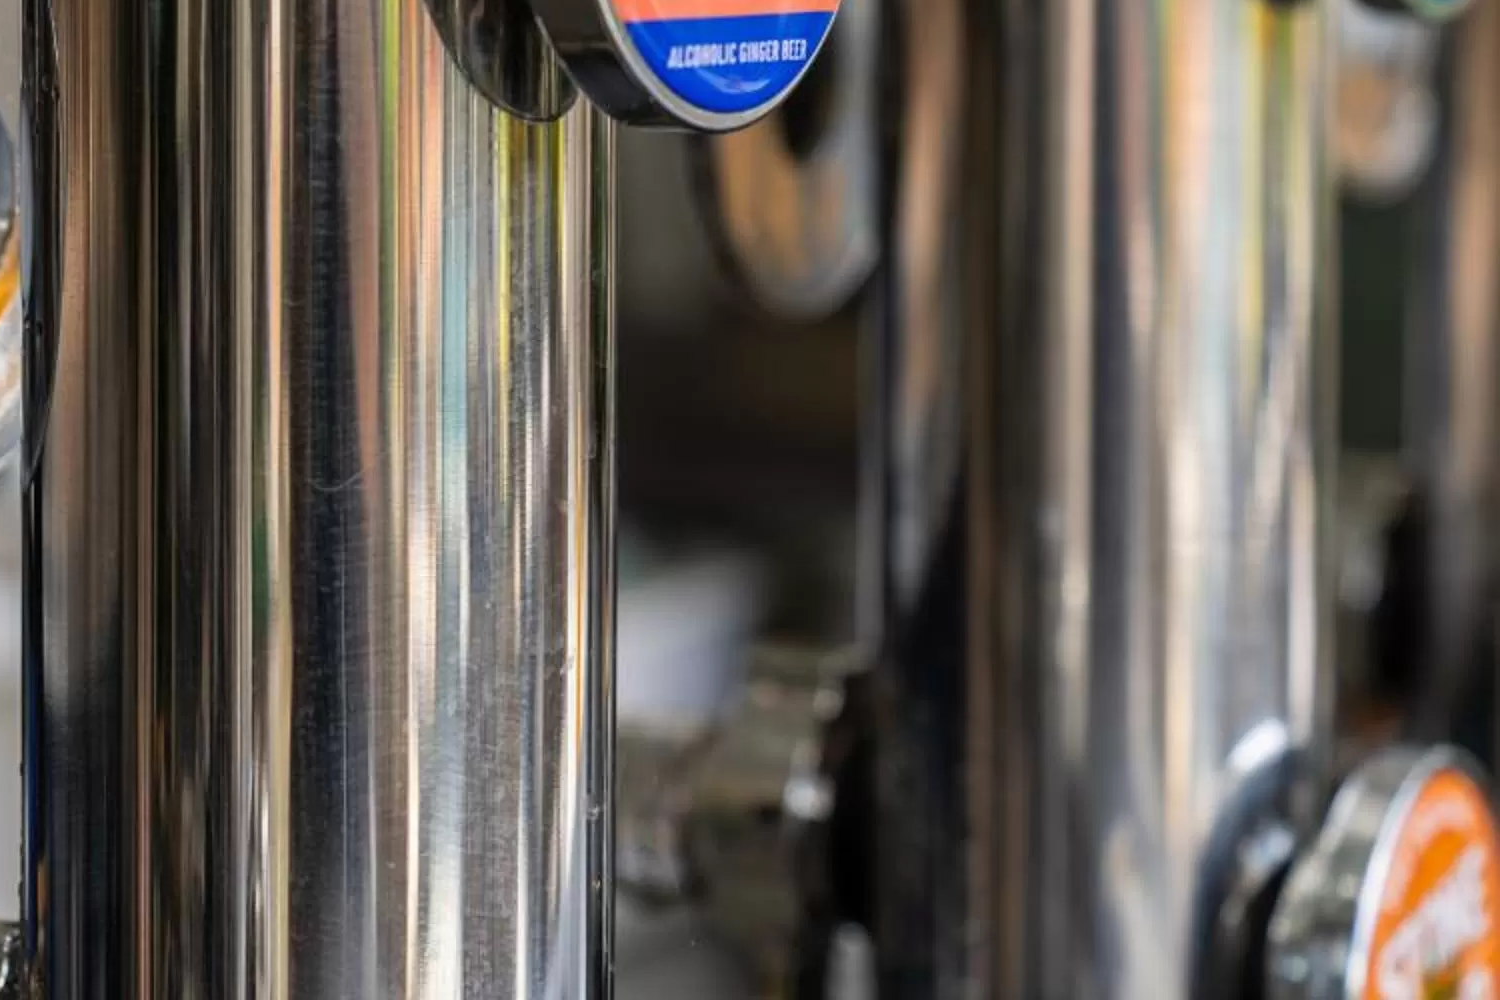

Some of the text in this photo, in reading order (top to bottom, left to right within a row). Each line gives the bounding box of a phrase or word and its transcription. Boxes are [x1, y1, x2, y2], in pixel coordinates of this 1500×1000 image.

[666, 38, 807, 69] ALCOHOLIC GINGER BEER
